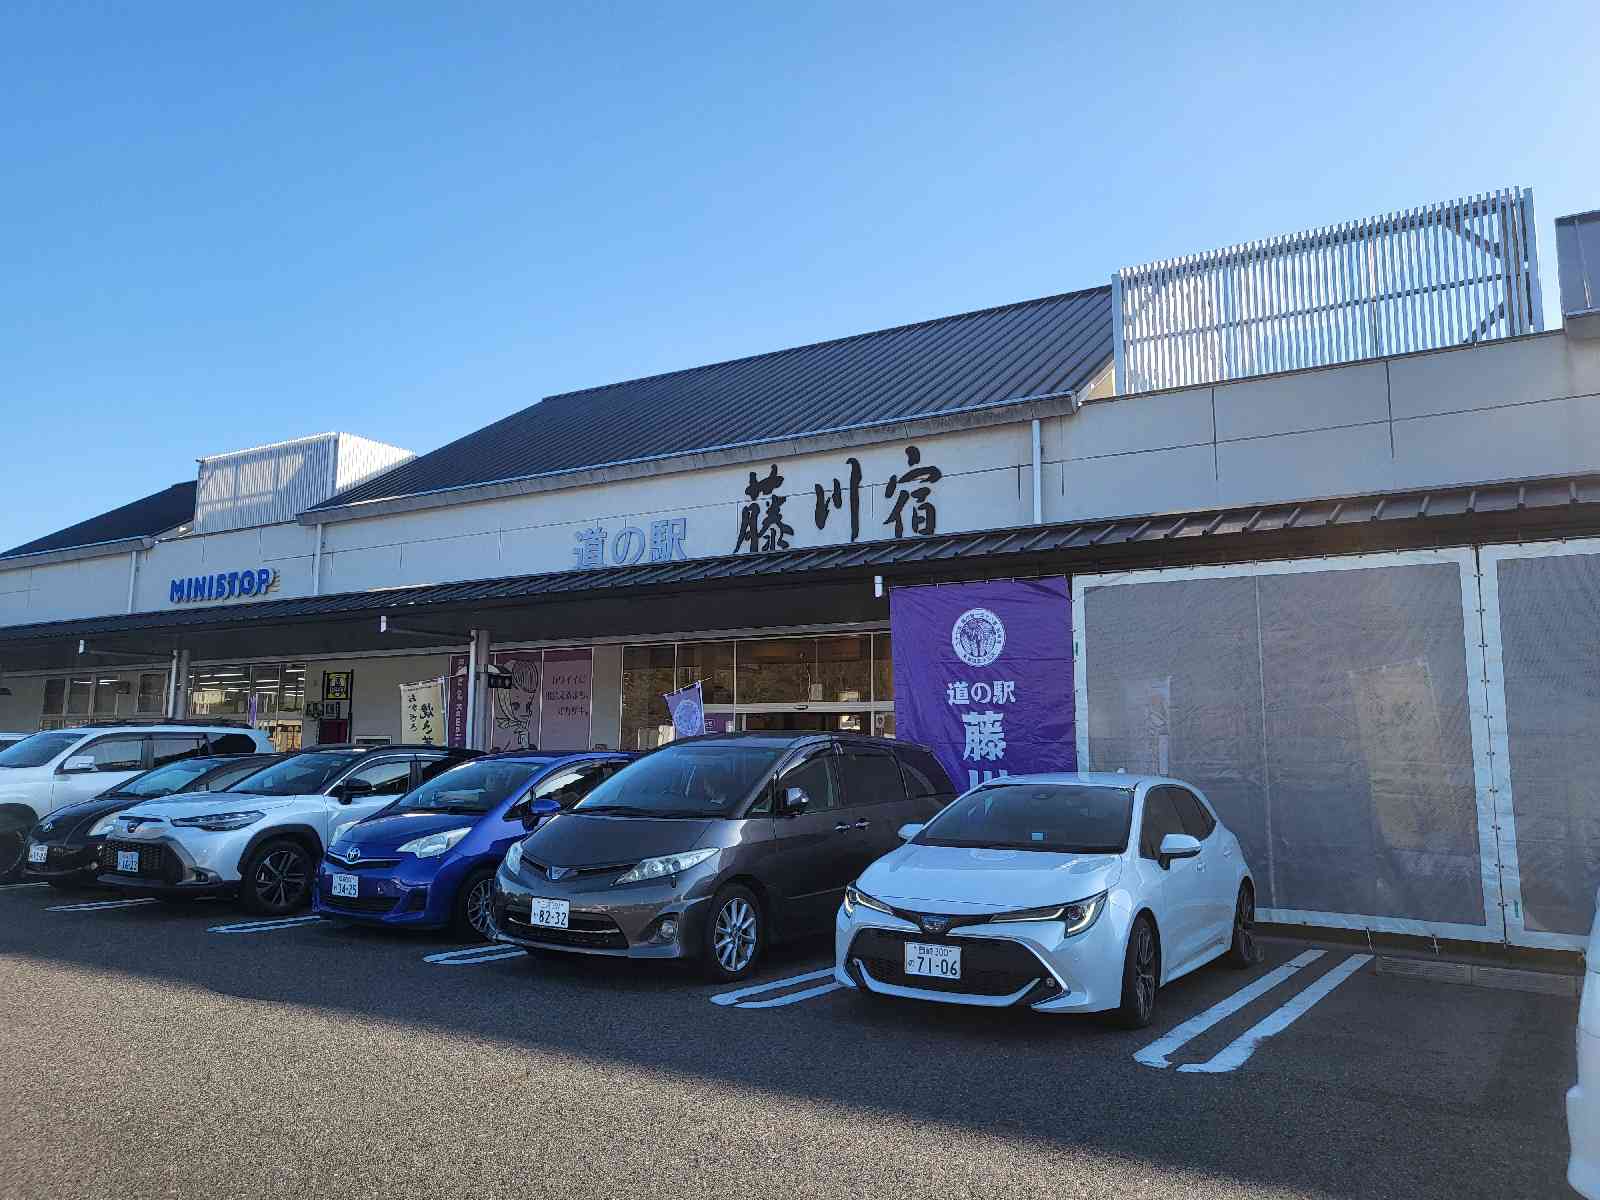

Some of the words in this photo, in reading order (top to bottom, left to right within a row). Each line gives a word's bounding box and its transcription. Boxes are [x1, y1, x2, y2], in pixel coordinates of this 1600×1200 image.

[573, 518, 688, 570] 道の駅
[733, 446, 942, 554] 藤川宿
[169, 568, 273, 603] MINISTOP
[947, 680, 1016, 706] 道の駅
[539, 910, 567, 926] 82-32
[917, 956, 958, 976] 71-06
